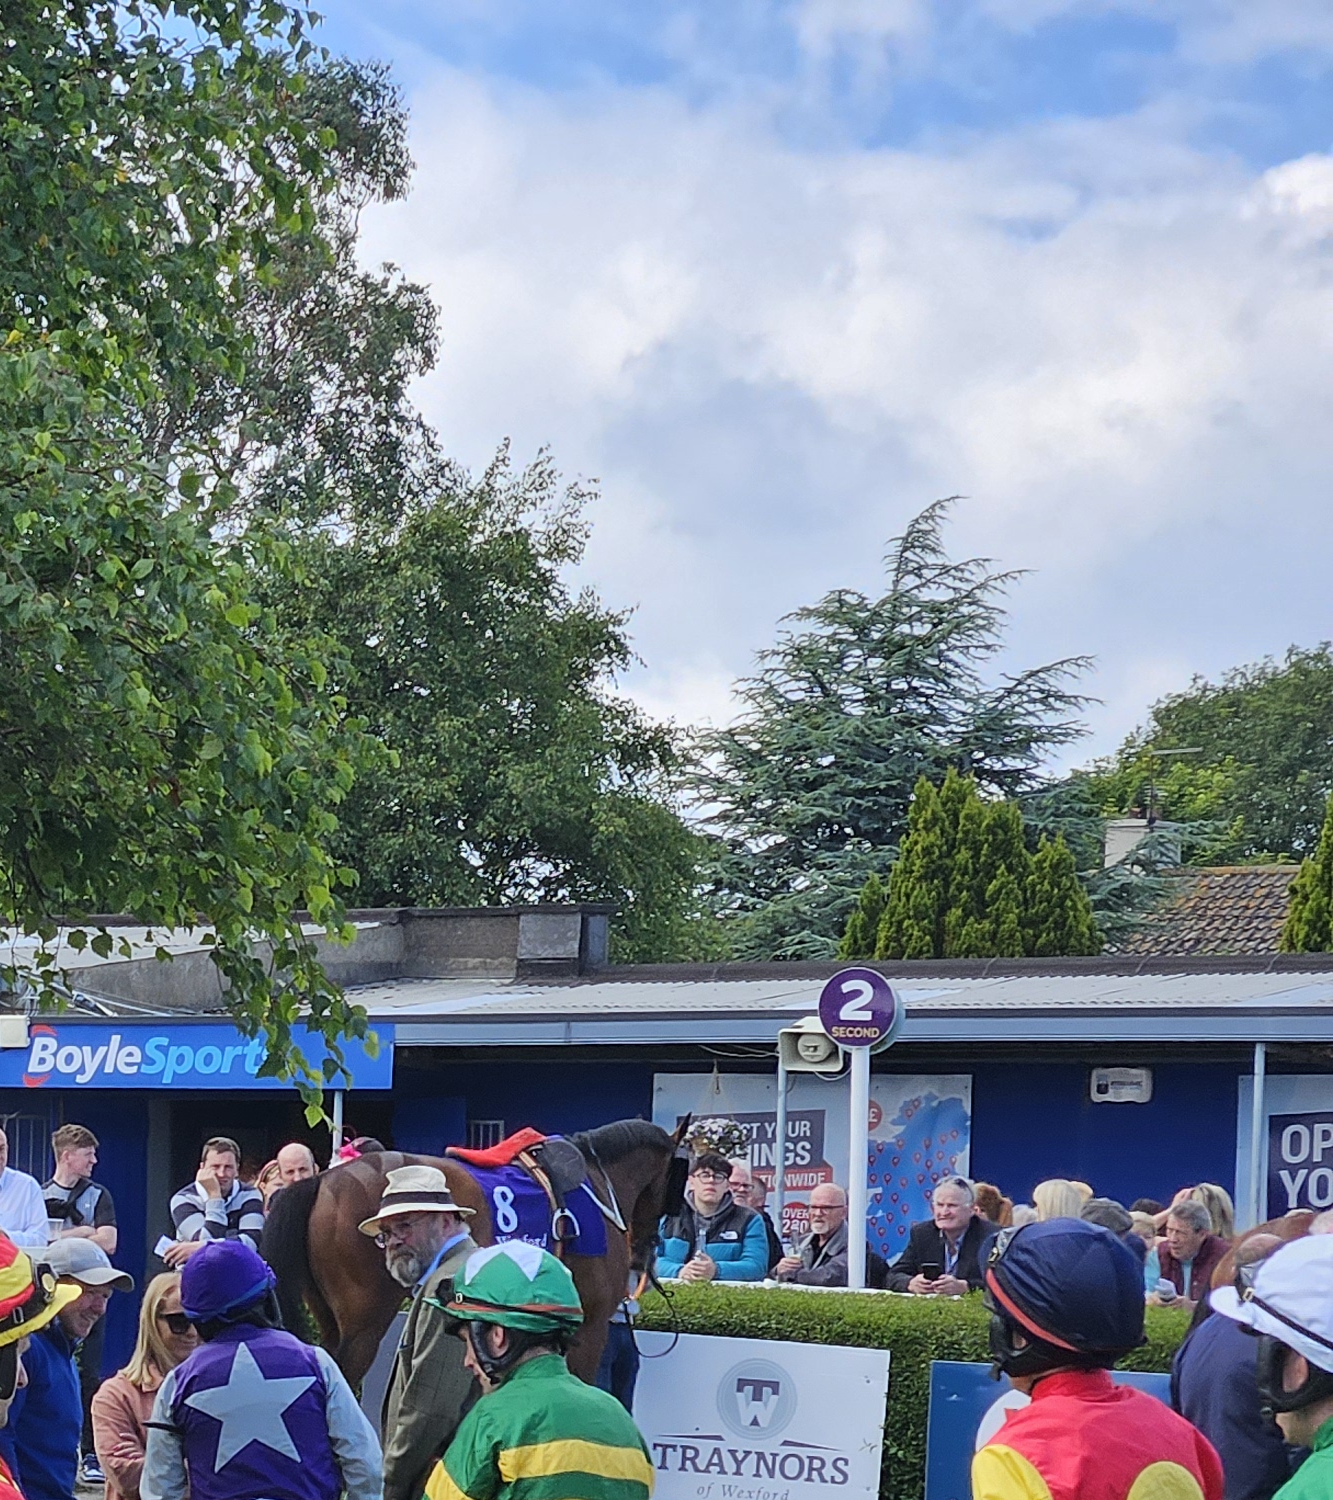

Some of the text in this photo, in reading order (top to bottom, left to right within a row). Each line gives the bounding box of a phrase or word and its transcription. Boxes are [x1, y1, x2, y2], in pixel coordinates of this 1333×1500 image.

[839, 979, 874, 1021] 2
[831, 1026, 880, 1039] SECOND
[27, 1035, 268, 1084] BoyleSport
[764, 1121, 811, 1139] YUR
[493, 1186, 518, 1233] 8
[652, 1442, 850, 1486] TRAYNORS
[696, 1483, 715, 1499] of
